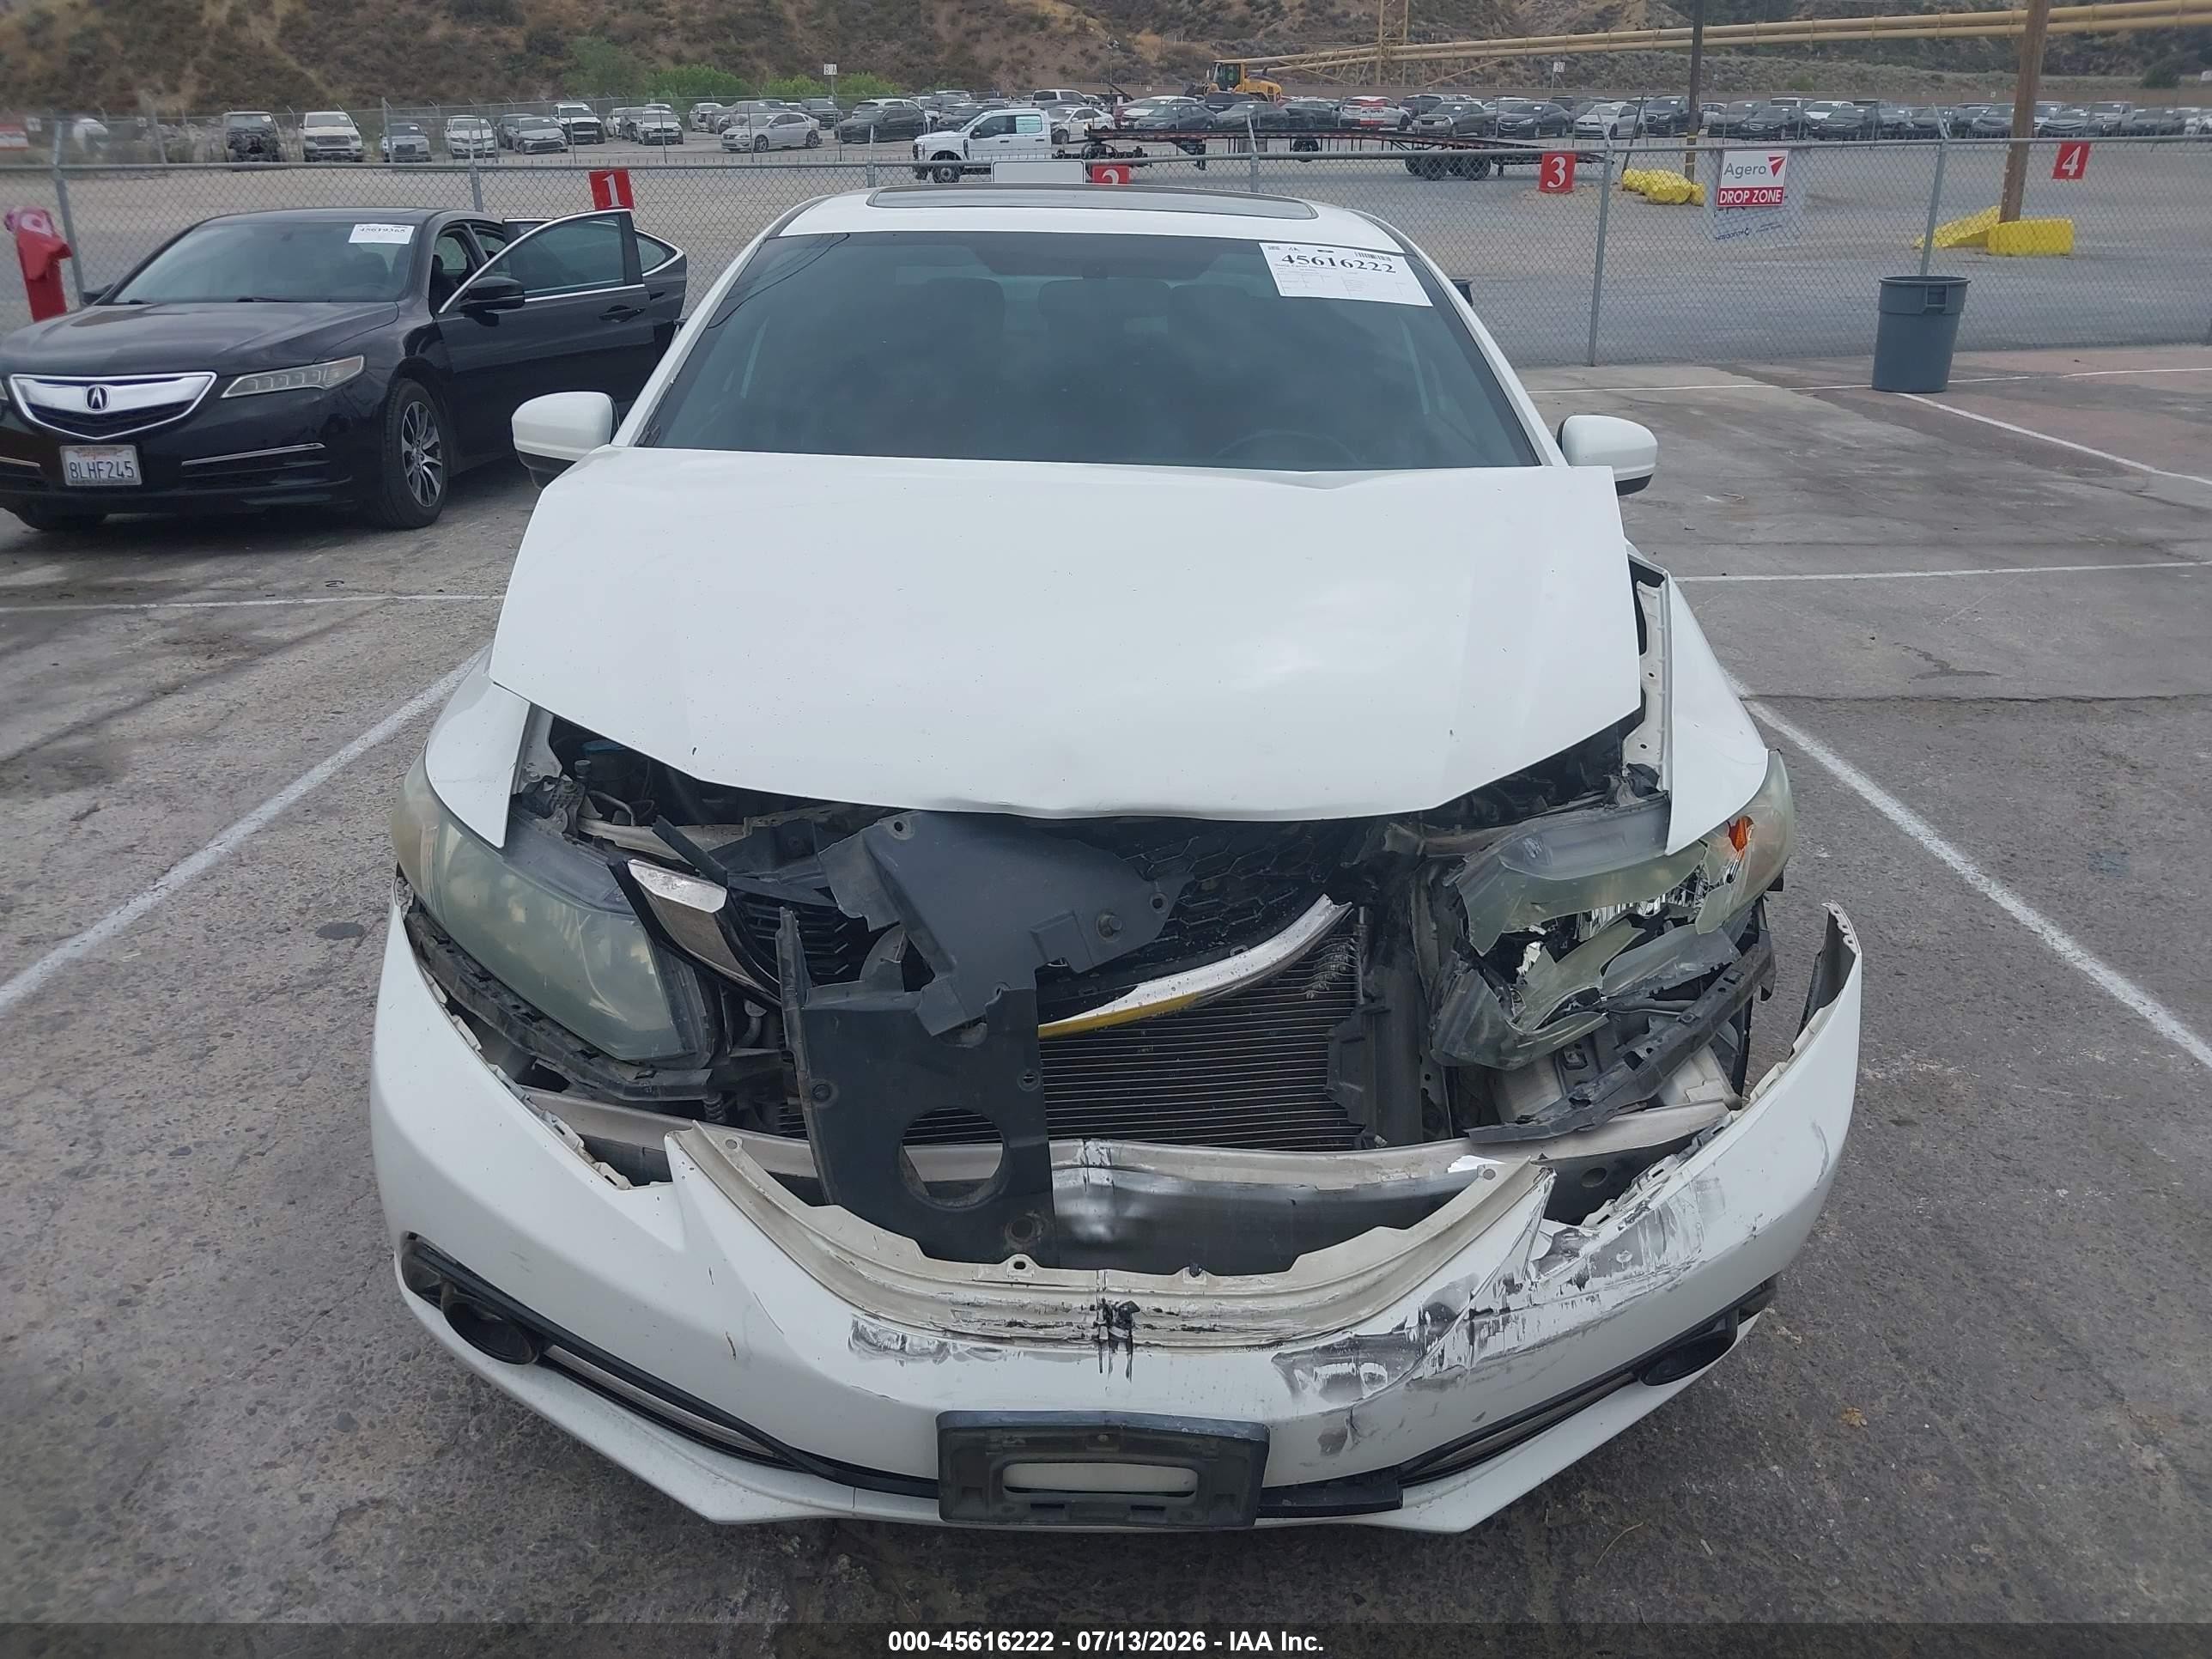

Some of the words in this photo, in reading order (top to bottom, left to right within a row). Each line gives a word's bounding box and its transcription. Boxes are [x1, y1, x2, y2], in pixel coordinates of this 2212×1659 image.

[2062, 146, 2081, 175] 4
[1547, 156, 1565, 187] 3
[1723, 163, 1766, 179] Agero
[603, 173, 624, 207] 1
[1719, 191, 1750, 204] DROP
[1752, 189, 1782, 203] ZONE
[1281, 254, 1396, 273] 45616222
[69, 461, 135, 478] 8LHF245
